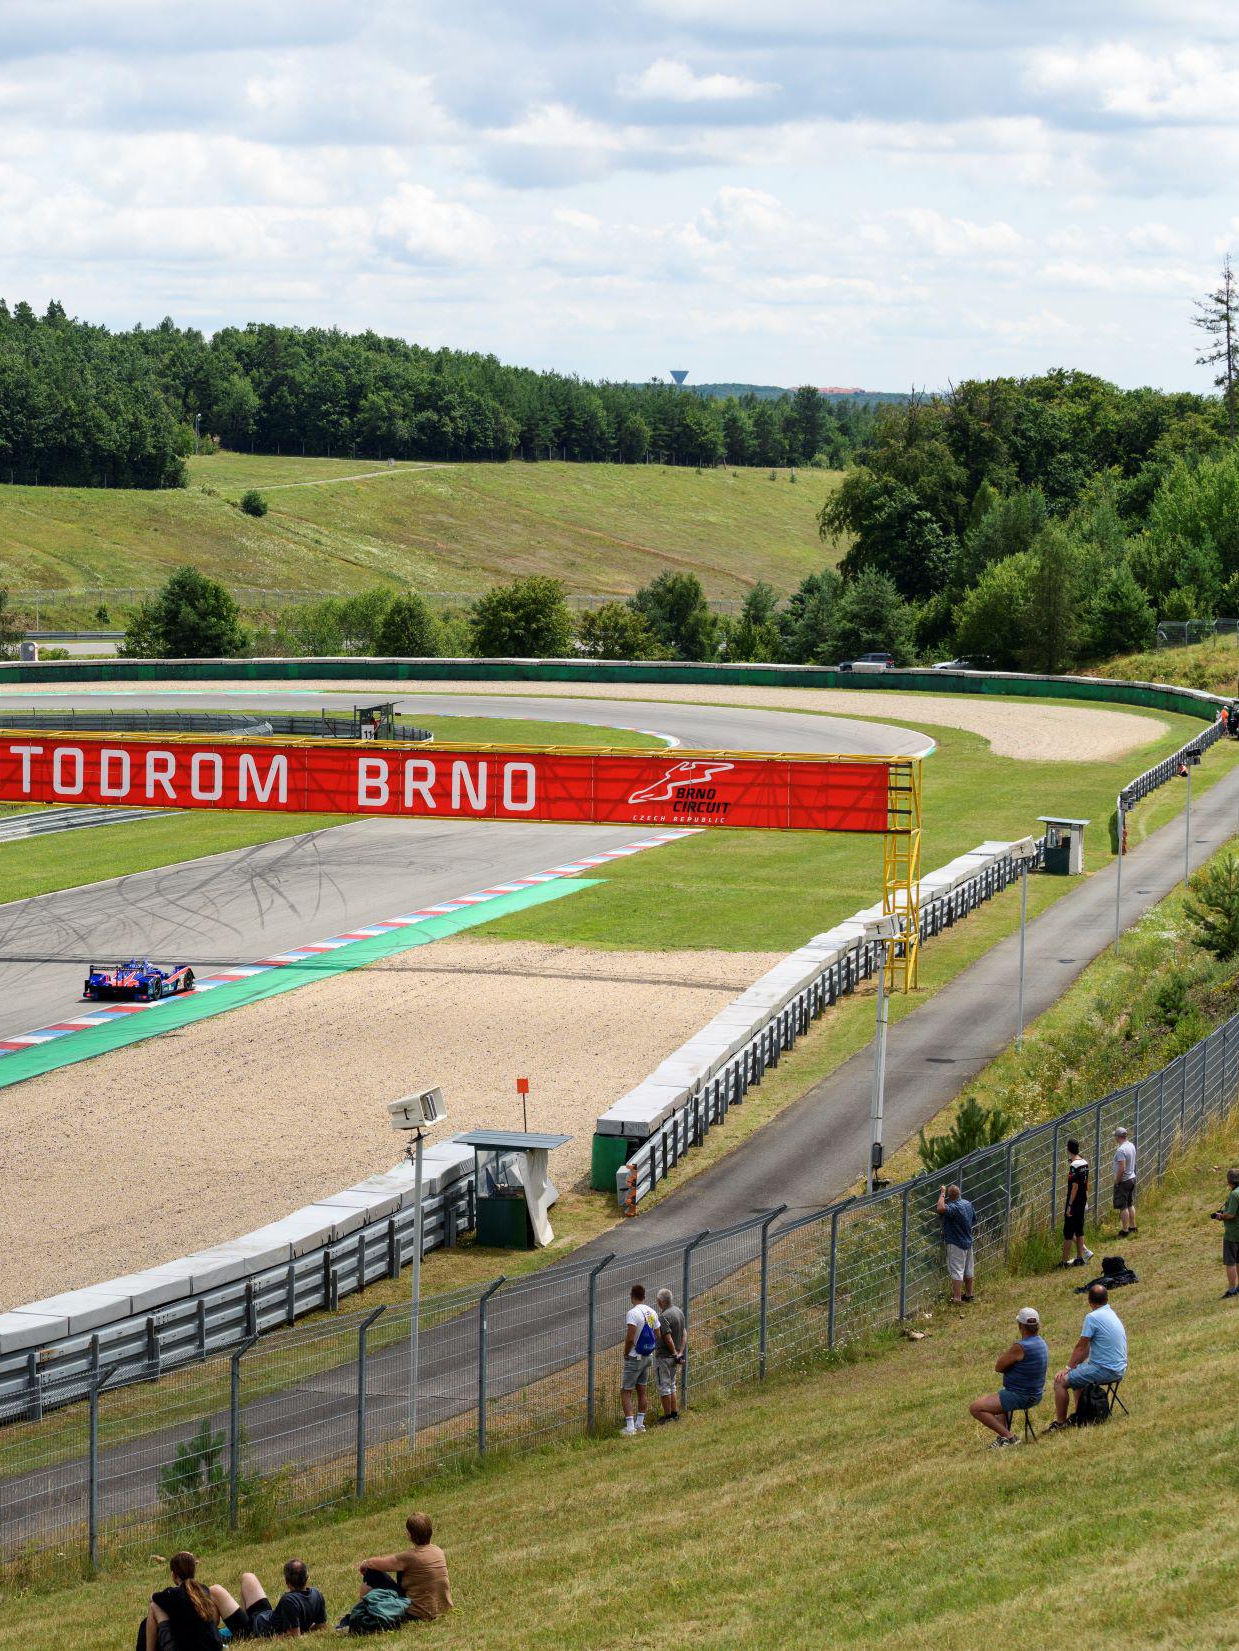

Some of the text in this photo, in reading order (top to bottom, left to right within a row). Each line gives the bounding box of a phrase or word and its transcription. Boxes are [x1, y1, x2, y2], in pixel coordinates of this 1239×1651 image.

[357, 757, 536, 811] BRNO
[676, 788, 716, 799] BRNO
[673, 801, 730, 813] CIRCUIT
